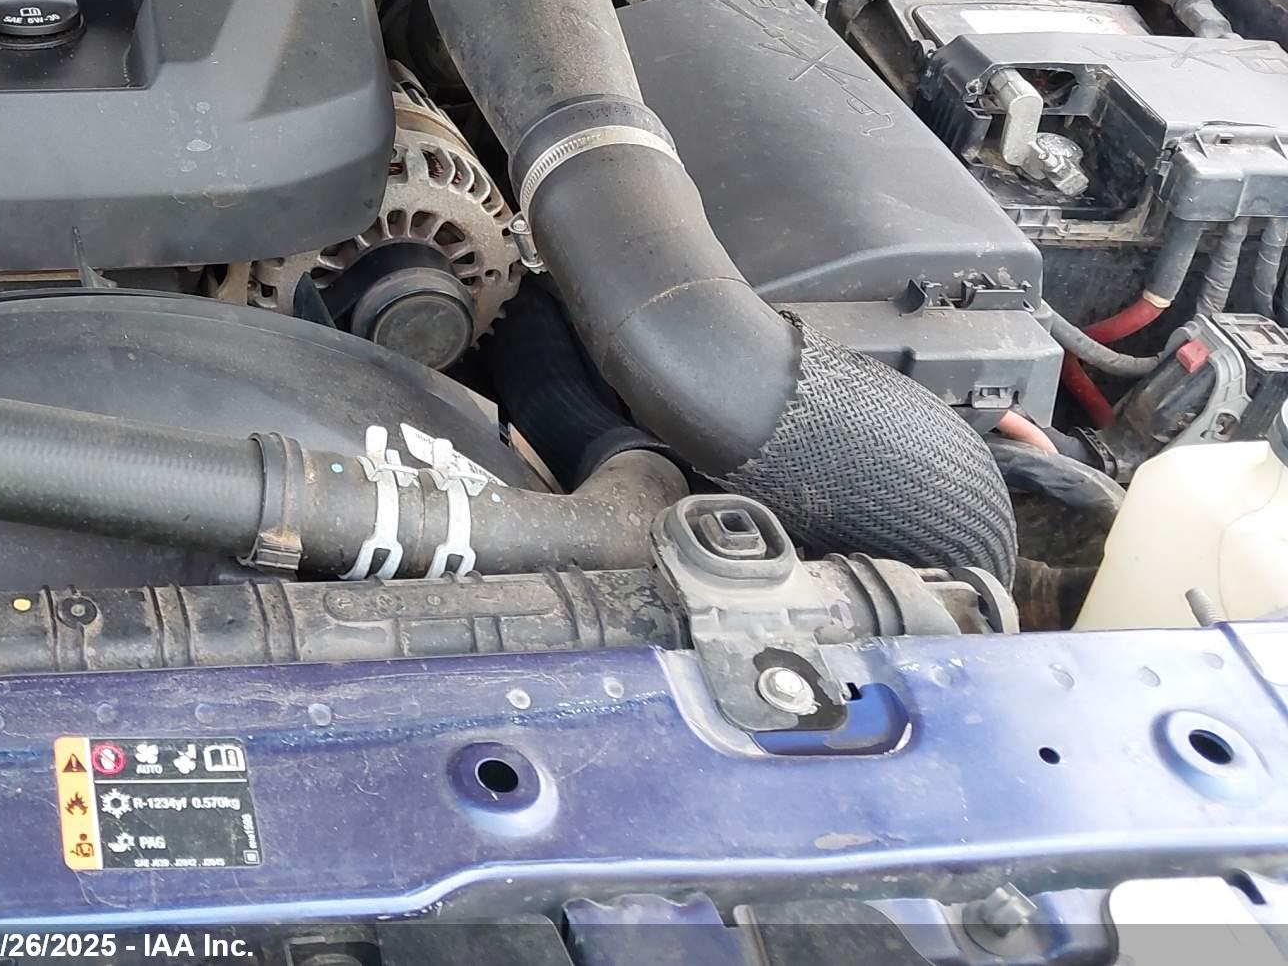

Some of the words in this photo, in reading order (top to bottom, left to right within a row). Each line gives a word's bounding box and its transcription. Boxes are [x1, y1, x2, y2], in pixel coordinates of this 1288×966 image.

[3, 15, 23, 24] SAE
[27, 13, 61, 24] 5W-30
[136, 764, 163, 774] AUTO
[133, 797, 187, 811] R-1234yf
[191, 796, 241, 811] 0.570kg
[138, 835, 167, 849] PAG
